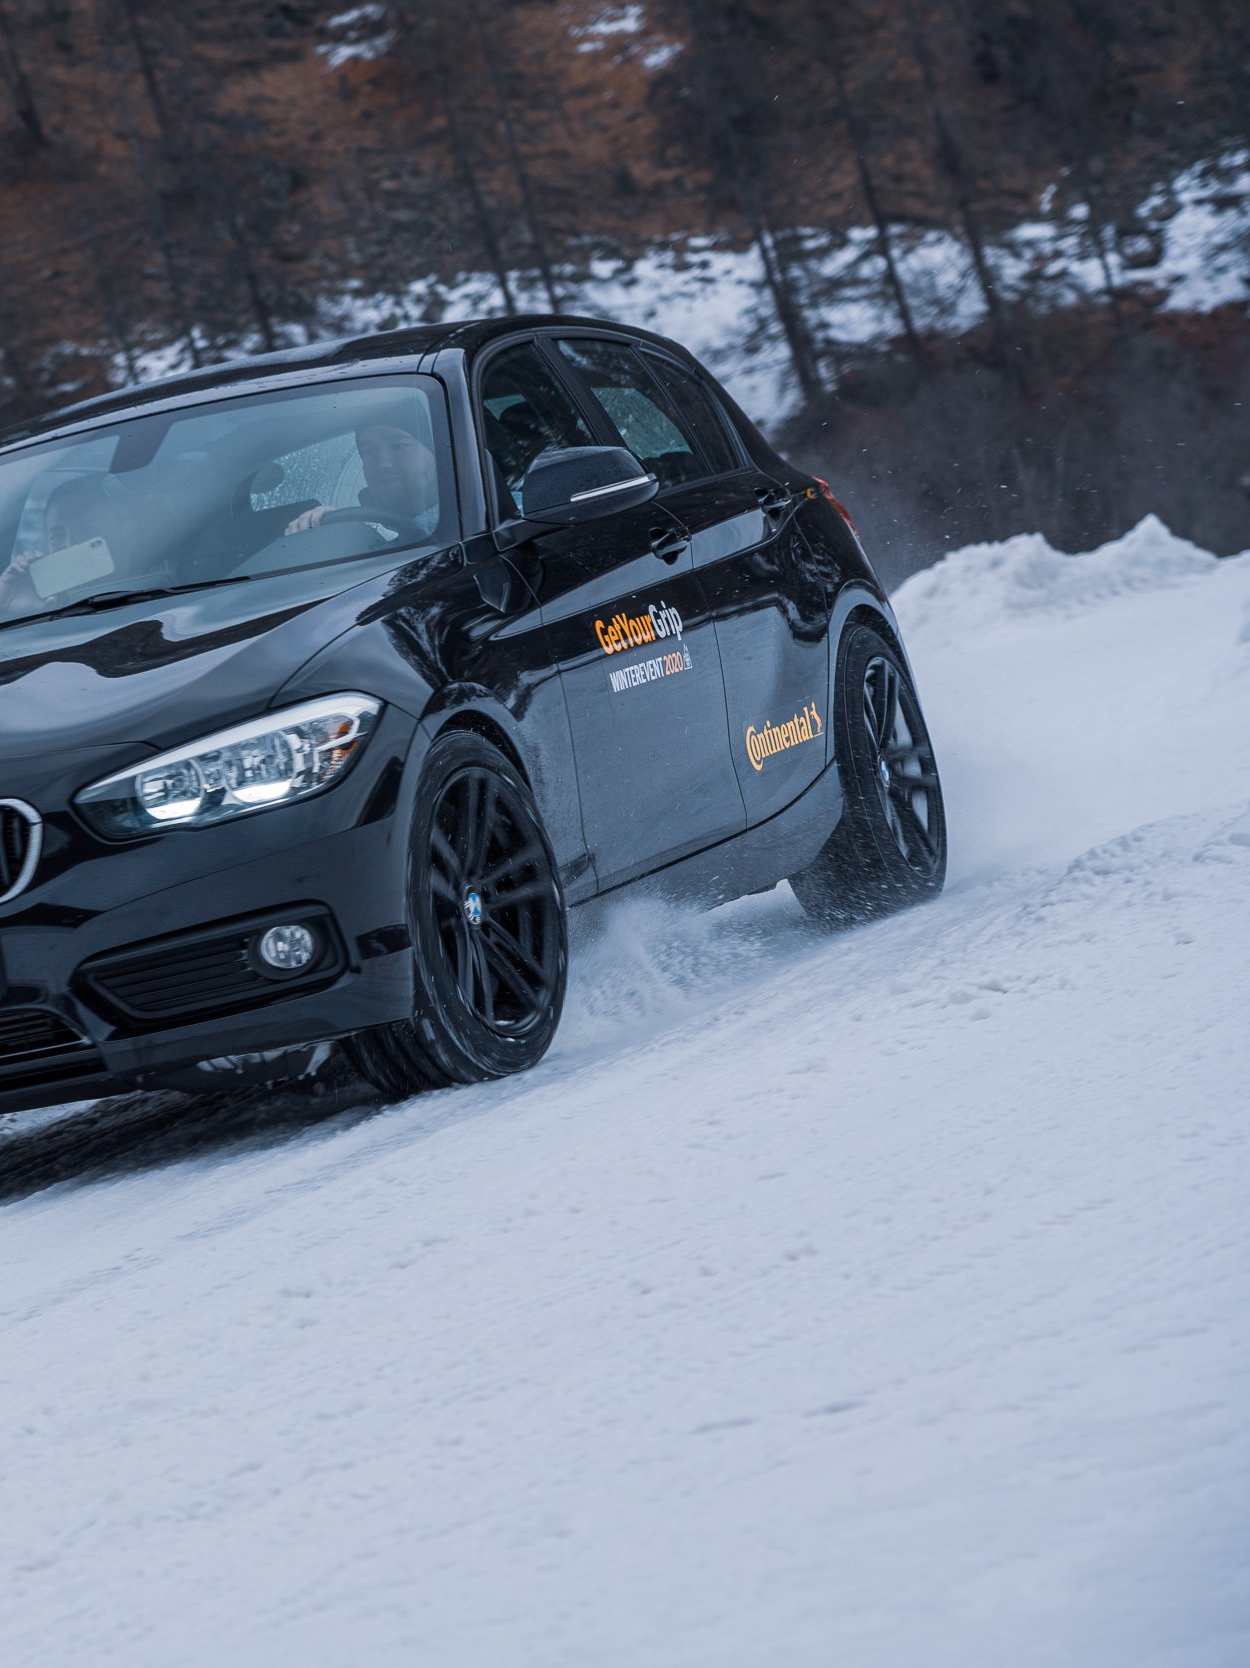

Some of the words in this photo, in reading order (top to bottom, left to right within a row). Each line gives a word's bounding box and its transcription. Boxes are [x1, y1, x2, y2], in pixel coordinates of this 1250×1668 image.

[594, 601, 683, 655] GetYourGrip
[609, 657, 664, 693] WINTEREVENT
[662, 651, 684, 676] 2020
[746, 707, 813, 771] Continental
